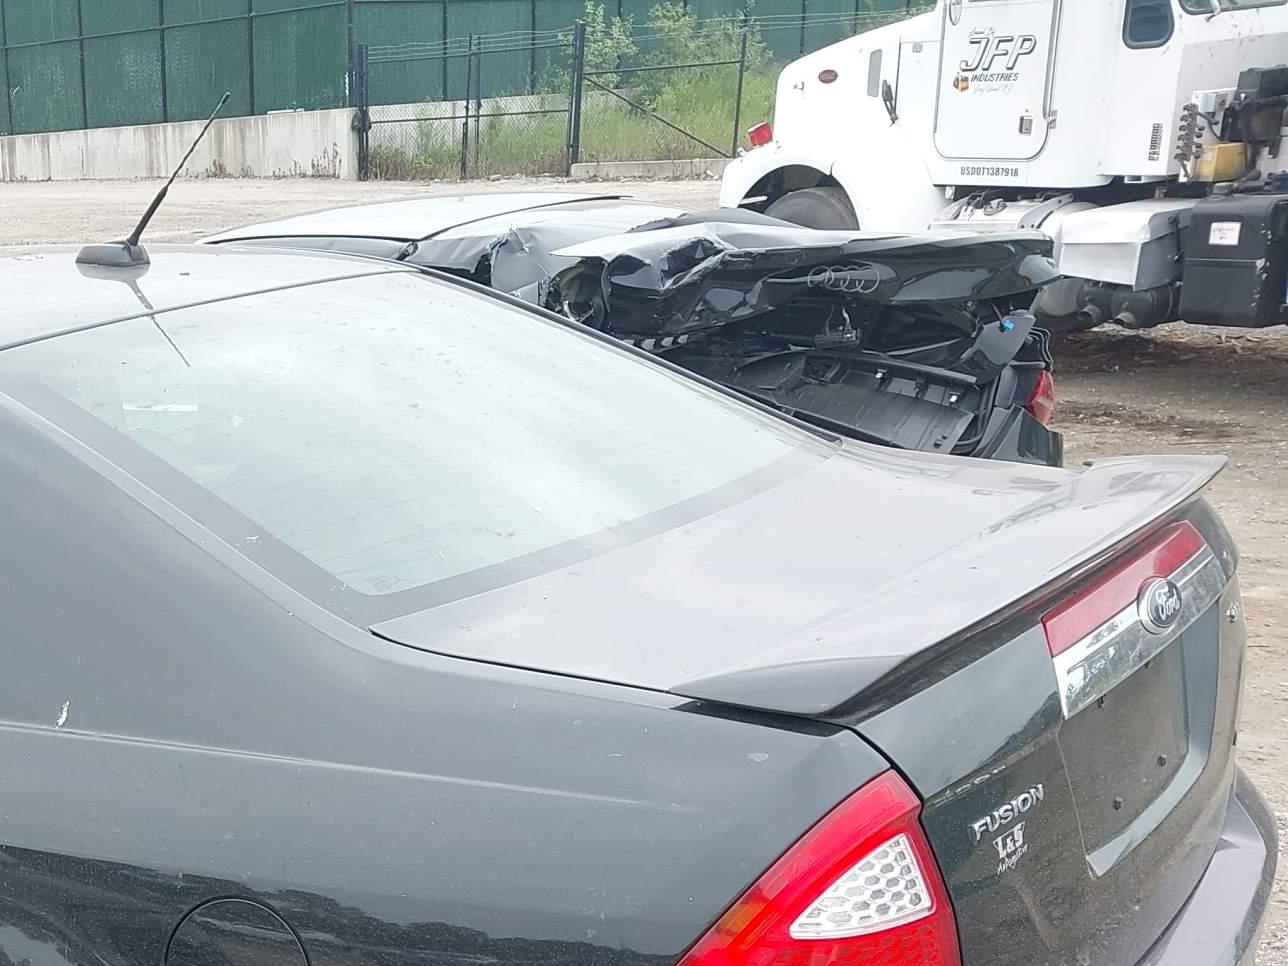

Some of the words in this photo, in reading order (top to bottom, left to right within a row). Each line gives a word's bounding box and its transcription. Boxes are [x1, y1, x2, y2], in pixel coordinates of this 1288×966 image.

[960, 34, 1037, 72] JFP
[970, 72, 1020, 82] INDUSTRIES
[1155, 586, 1180, 621] Ford
[971, 783, 1045, 842] FUSION
[993, 821, 1026, 859] L&S
